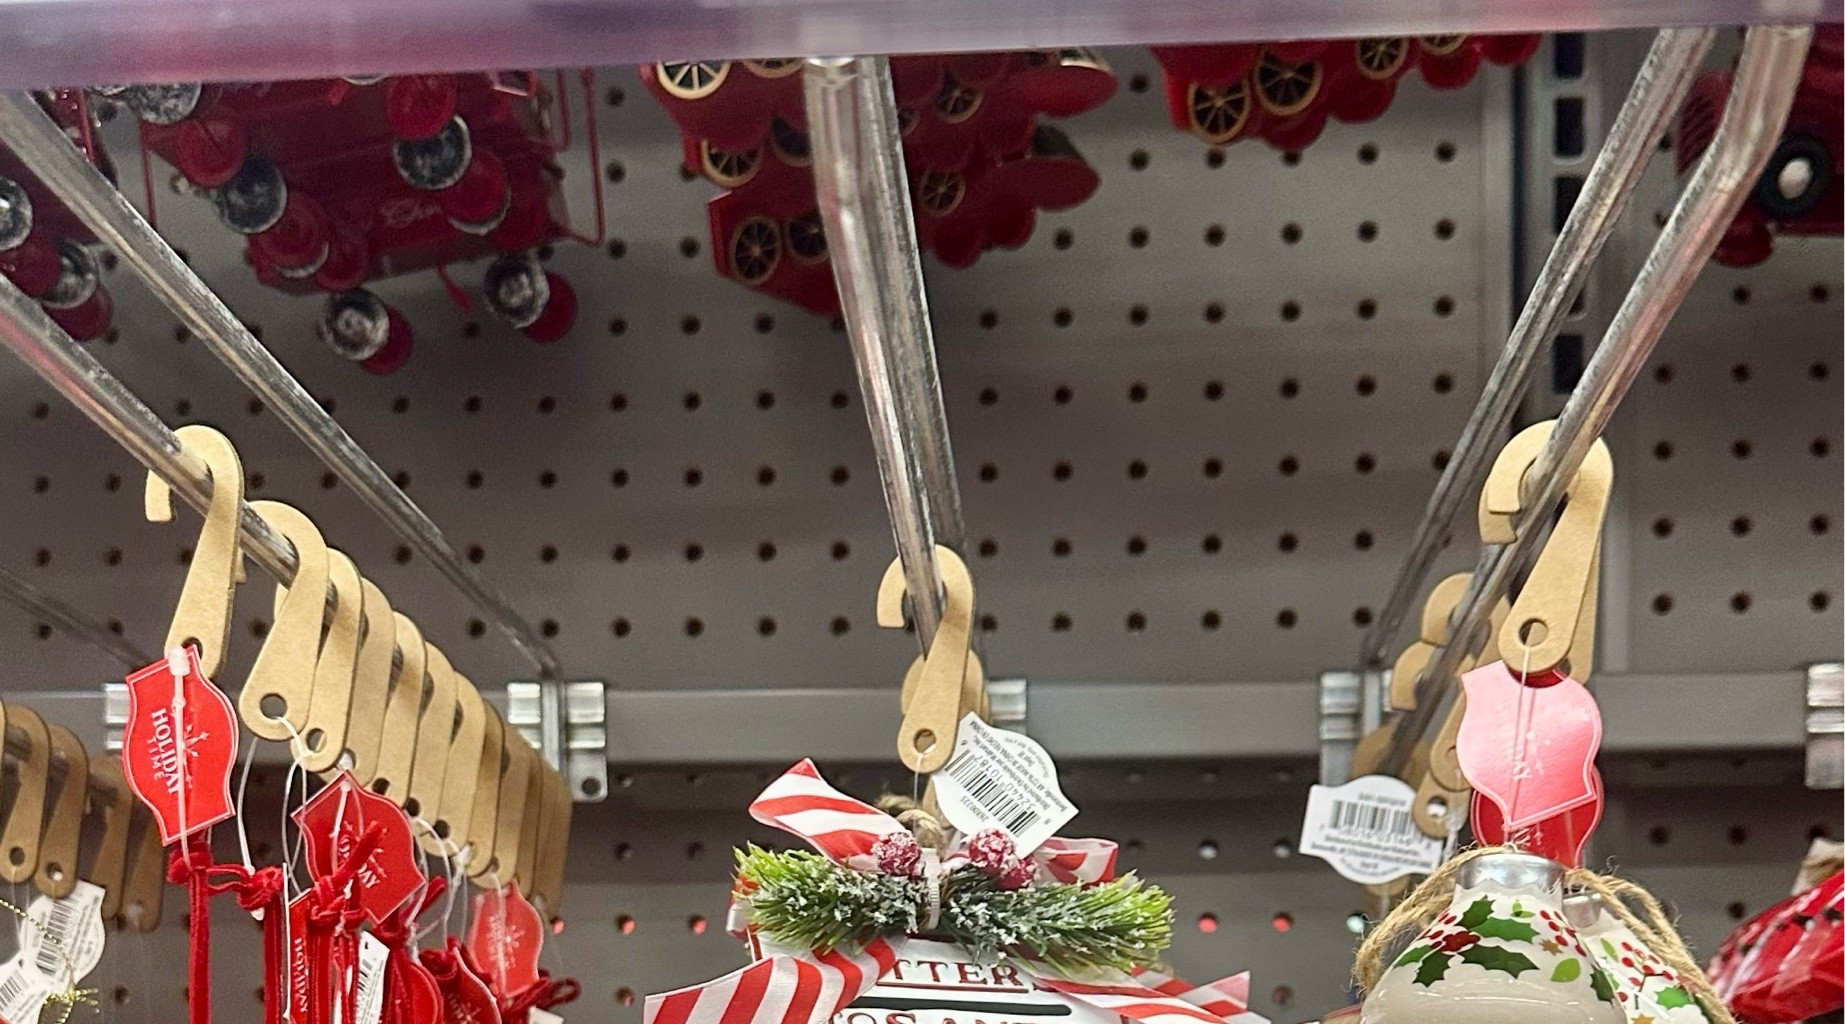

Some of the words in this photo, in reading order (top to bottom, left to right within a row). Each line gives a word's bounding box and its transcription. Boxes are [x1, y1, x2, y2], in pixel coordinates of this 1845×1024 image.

[147, 737, 165, 781] TIME
[151, 708, 180, 795] HOLIDAY
[973, 753, 1003, 781] 10187
[1004, 782, 1035, 811] 32440
